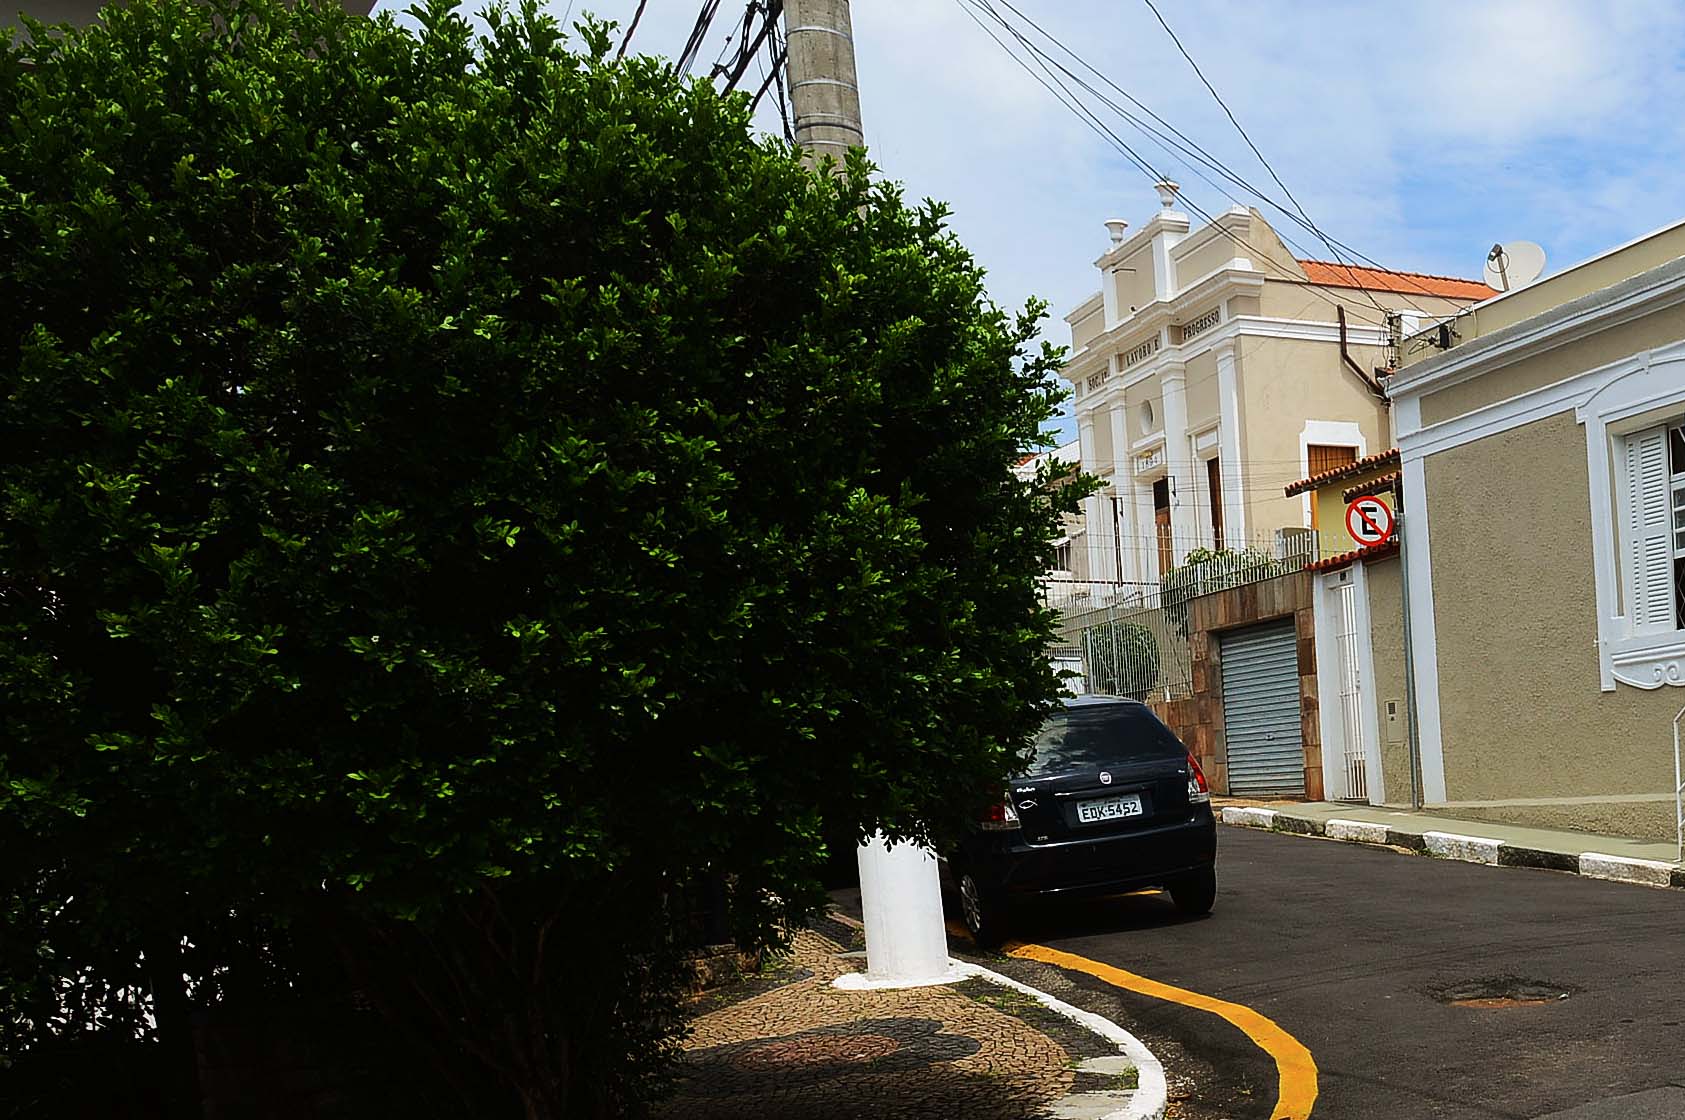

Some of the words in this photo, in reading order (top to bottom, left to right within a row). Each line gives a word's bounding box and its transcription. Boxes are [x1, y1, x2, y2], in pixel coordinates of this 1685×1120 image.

[1127, 343, 1151, 367] LAVORO
[1183, 310, 1220, 341] PROGRESSO
[1360, 506, 1381, 536] E
